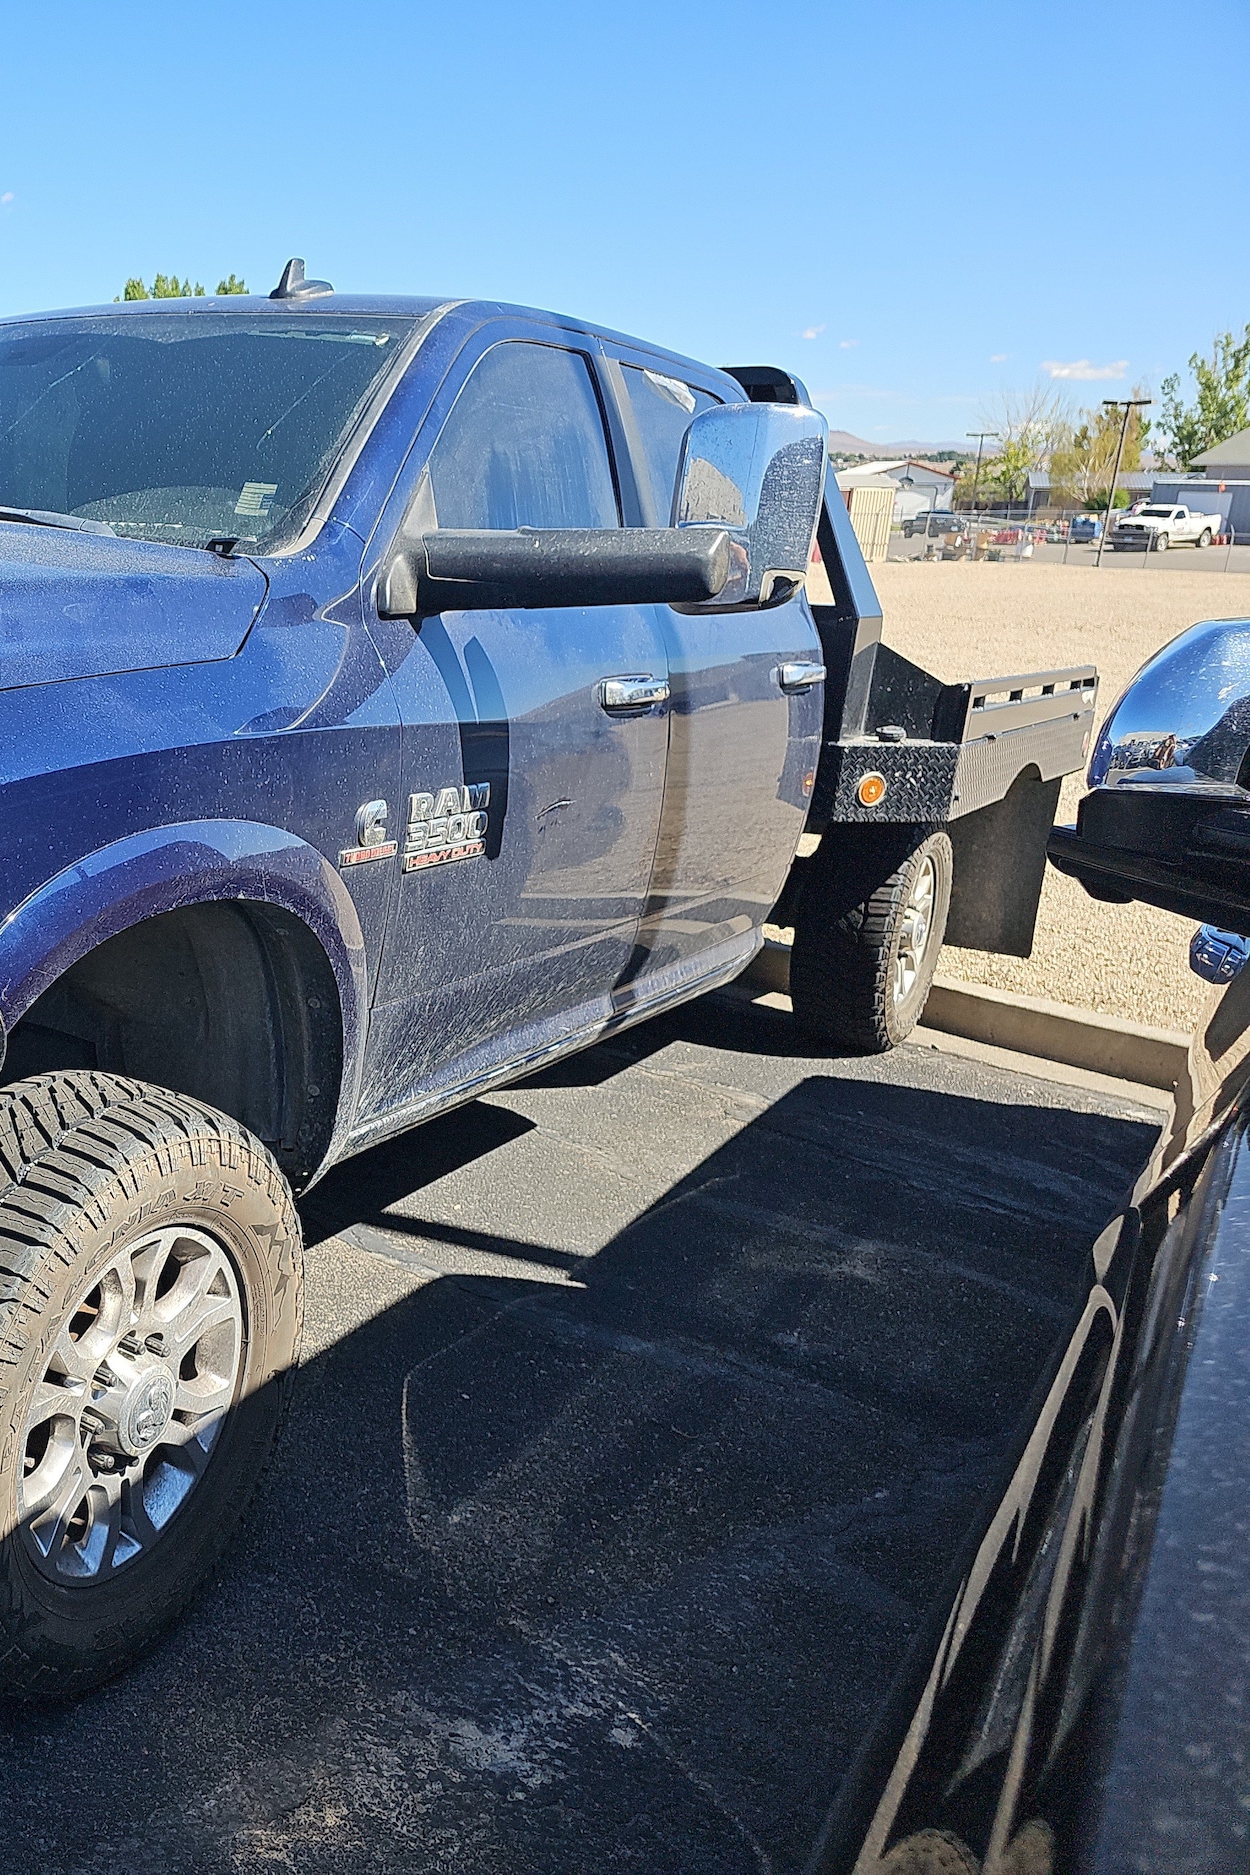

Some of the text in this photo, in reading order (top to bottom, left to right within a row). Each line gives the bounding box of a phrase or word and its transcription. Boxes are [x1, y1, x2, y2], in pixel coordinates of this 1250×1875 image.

[408, 782, 490, 822] RAM
[404, 810, 489, 853] 3500
[409, 842, 483, 868] HEAVY DUTY
